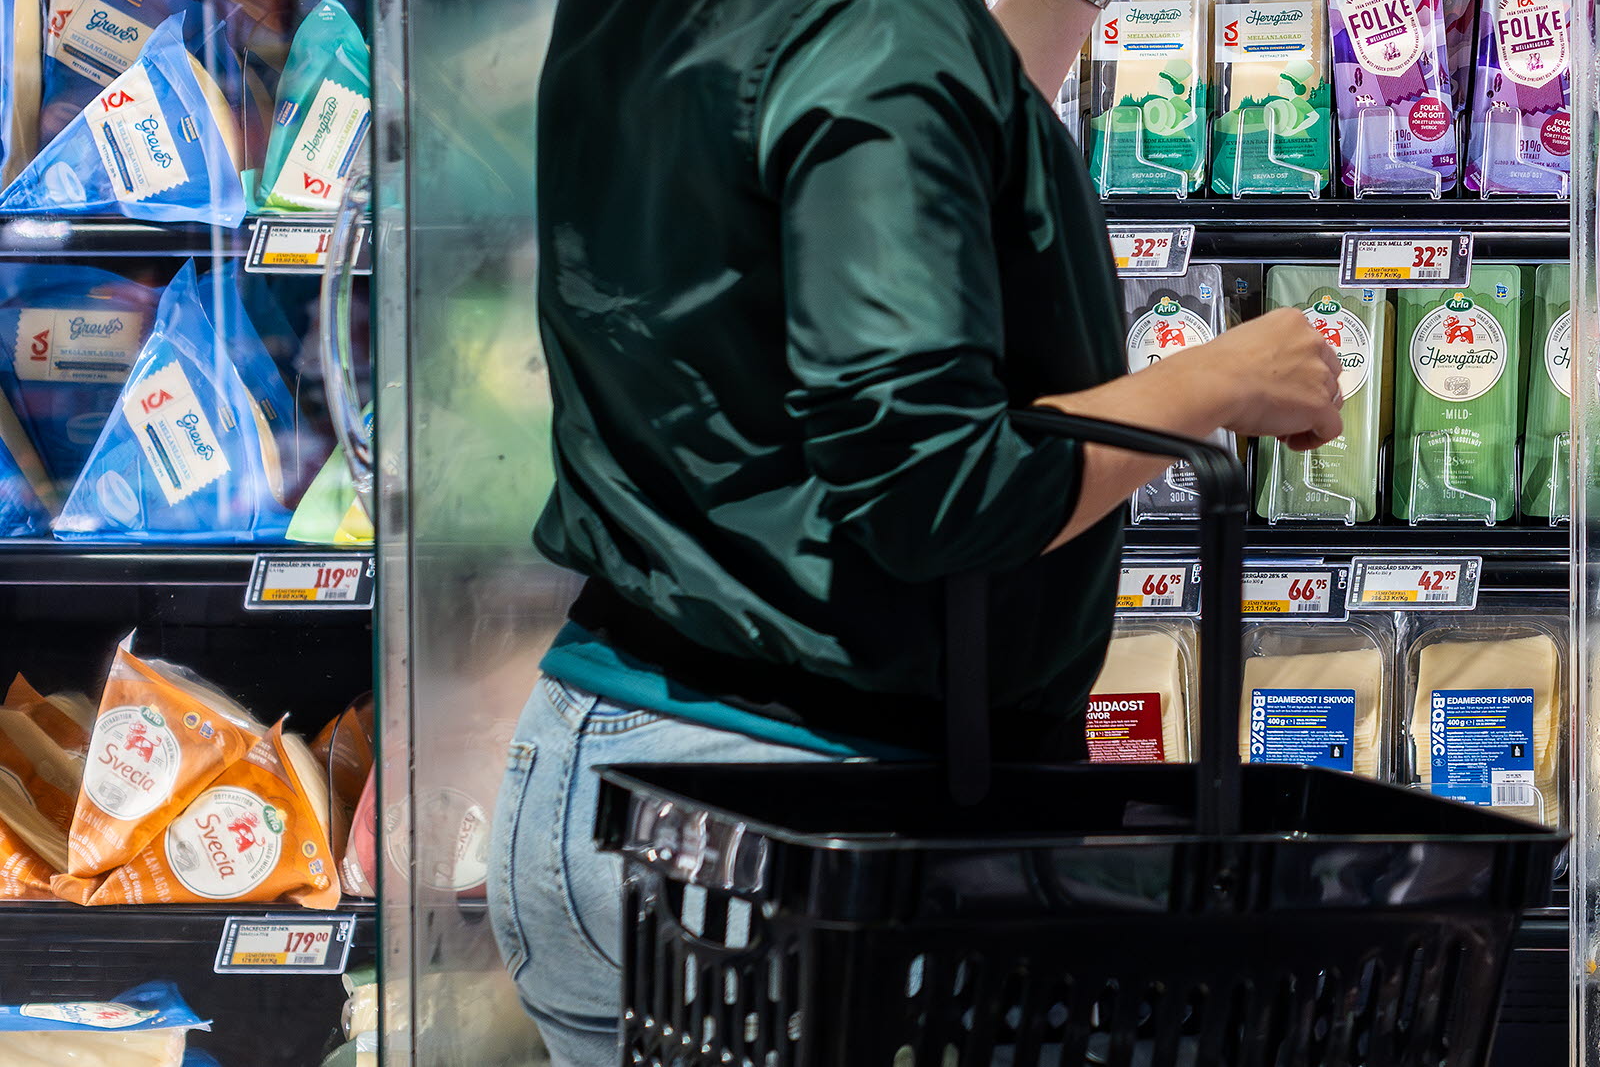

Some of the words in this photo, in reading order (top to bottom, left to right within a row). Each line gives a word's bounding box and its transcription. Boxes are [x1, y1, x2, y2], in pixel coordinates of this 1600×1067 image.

[1125, 8, 1182, 27] Herrgård
[1245, 9, 1303, 27] Herrgård
[1498, 10, 1563, 44] FOLKE
[1104, 18, 1119, 44] ICA
[1127, 32, 1181, 40] MELLANLAGRAD
[1224, 20, 1239, 46] ICA
[1247, 33, 1302, 41] MELLANLAGRAD
[101, 89, 135, 112] ICA
[1419, 104, 1440, 112] FOLKE
[1413, 111, 1427, 119] GÖR
[1428, 111, 1445, 119] GOTT
[303, 171, 332, 199] ICA
[1157, 303, 1178, 315] Arla
[1317, 302, 1338, 314] Arla
[1449, 299, 1469, 309] Arla
[30, 329, 50, 361] ICA
[1419, 345, 1498, 371] Herrgård
[141, 389, 174, 413] ICA
[1267, 696, 1318, 704] EDAMEROST
[1323, 696, 1354, 704] SKIVOR
[1447, 696, 1496, 705] EDAMEROST
[1502, 696, 1533, 704] SKIVOR
[98, 743, 156, 794] Svecia
[194, 812, 237, 881] Svecia
